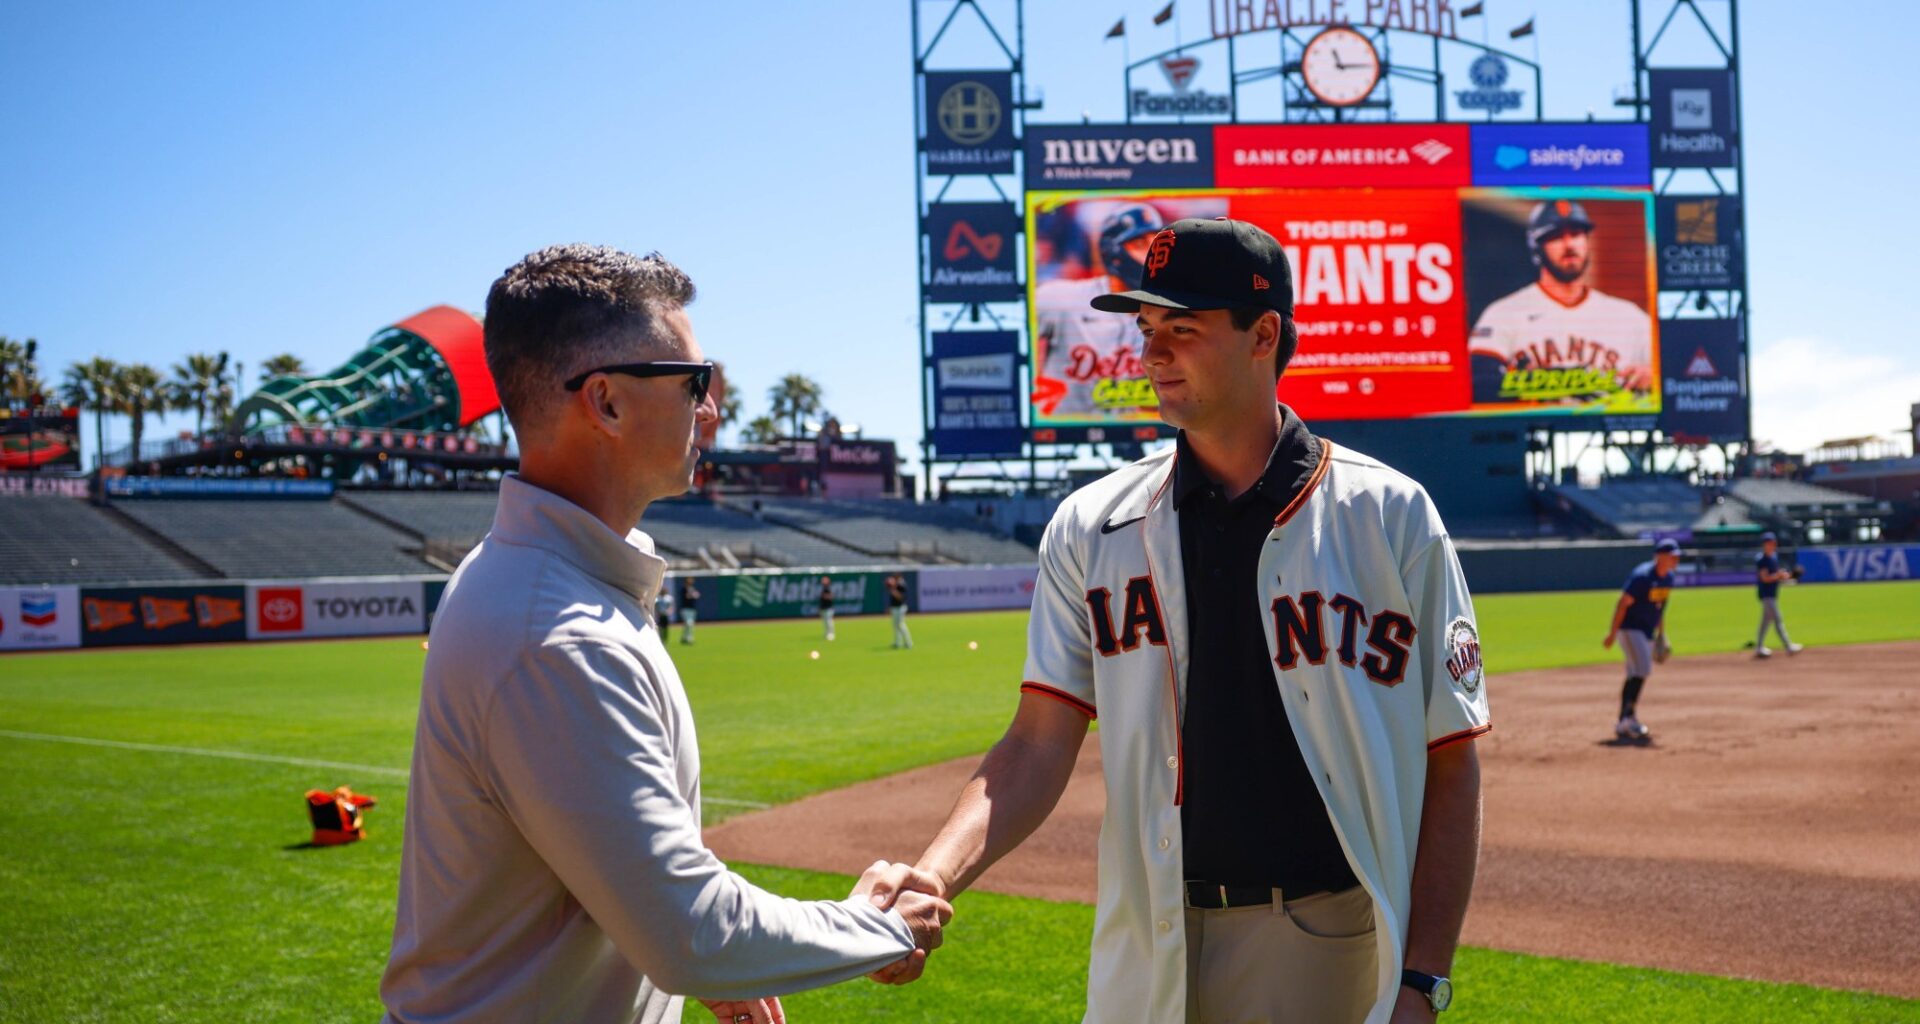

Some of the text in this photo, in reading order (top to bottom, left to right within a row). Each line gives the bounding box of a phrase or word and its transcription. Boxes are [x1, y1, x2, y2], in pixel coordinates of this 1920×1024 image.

[1131, 89, 1231, 115] Fanatics
[1042, 138, 1198, 164] nuveen
[1660, 132, 1725, 154] Health
[1233, 147, 1410, 166] BANK OF AMERICA
[1529, 145, 1624, 171] salesforce
[1284, 219, 1387, 240] TIGERS
[1284, 242, 1454, 305] IANTS
[1665, 376, 1738, 397] Benjamin
[1675, 396, 1729, 412] Moore
[1829, 547, 1910, 580] VISA
[766, 575, 867, 604] Natinal
[313, 596, 417, 619] TOYOTA
